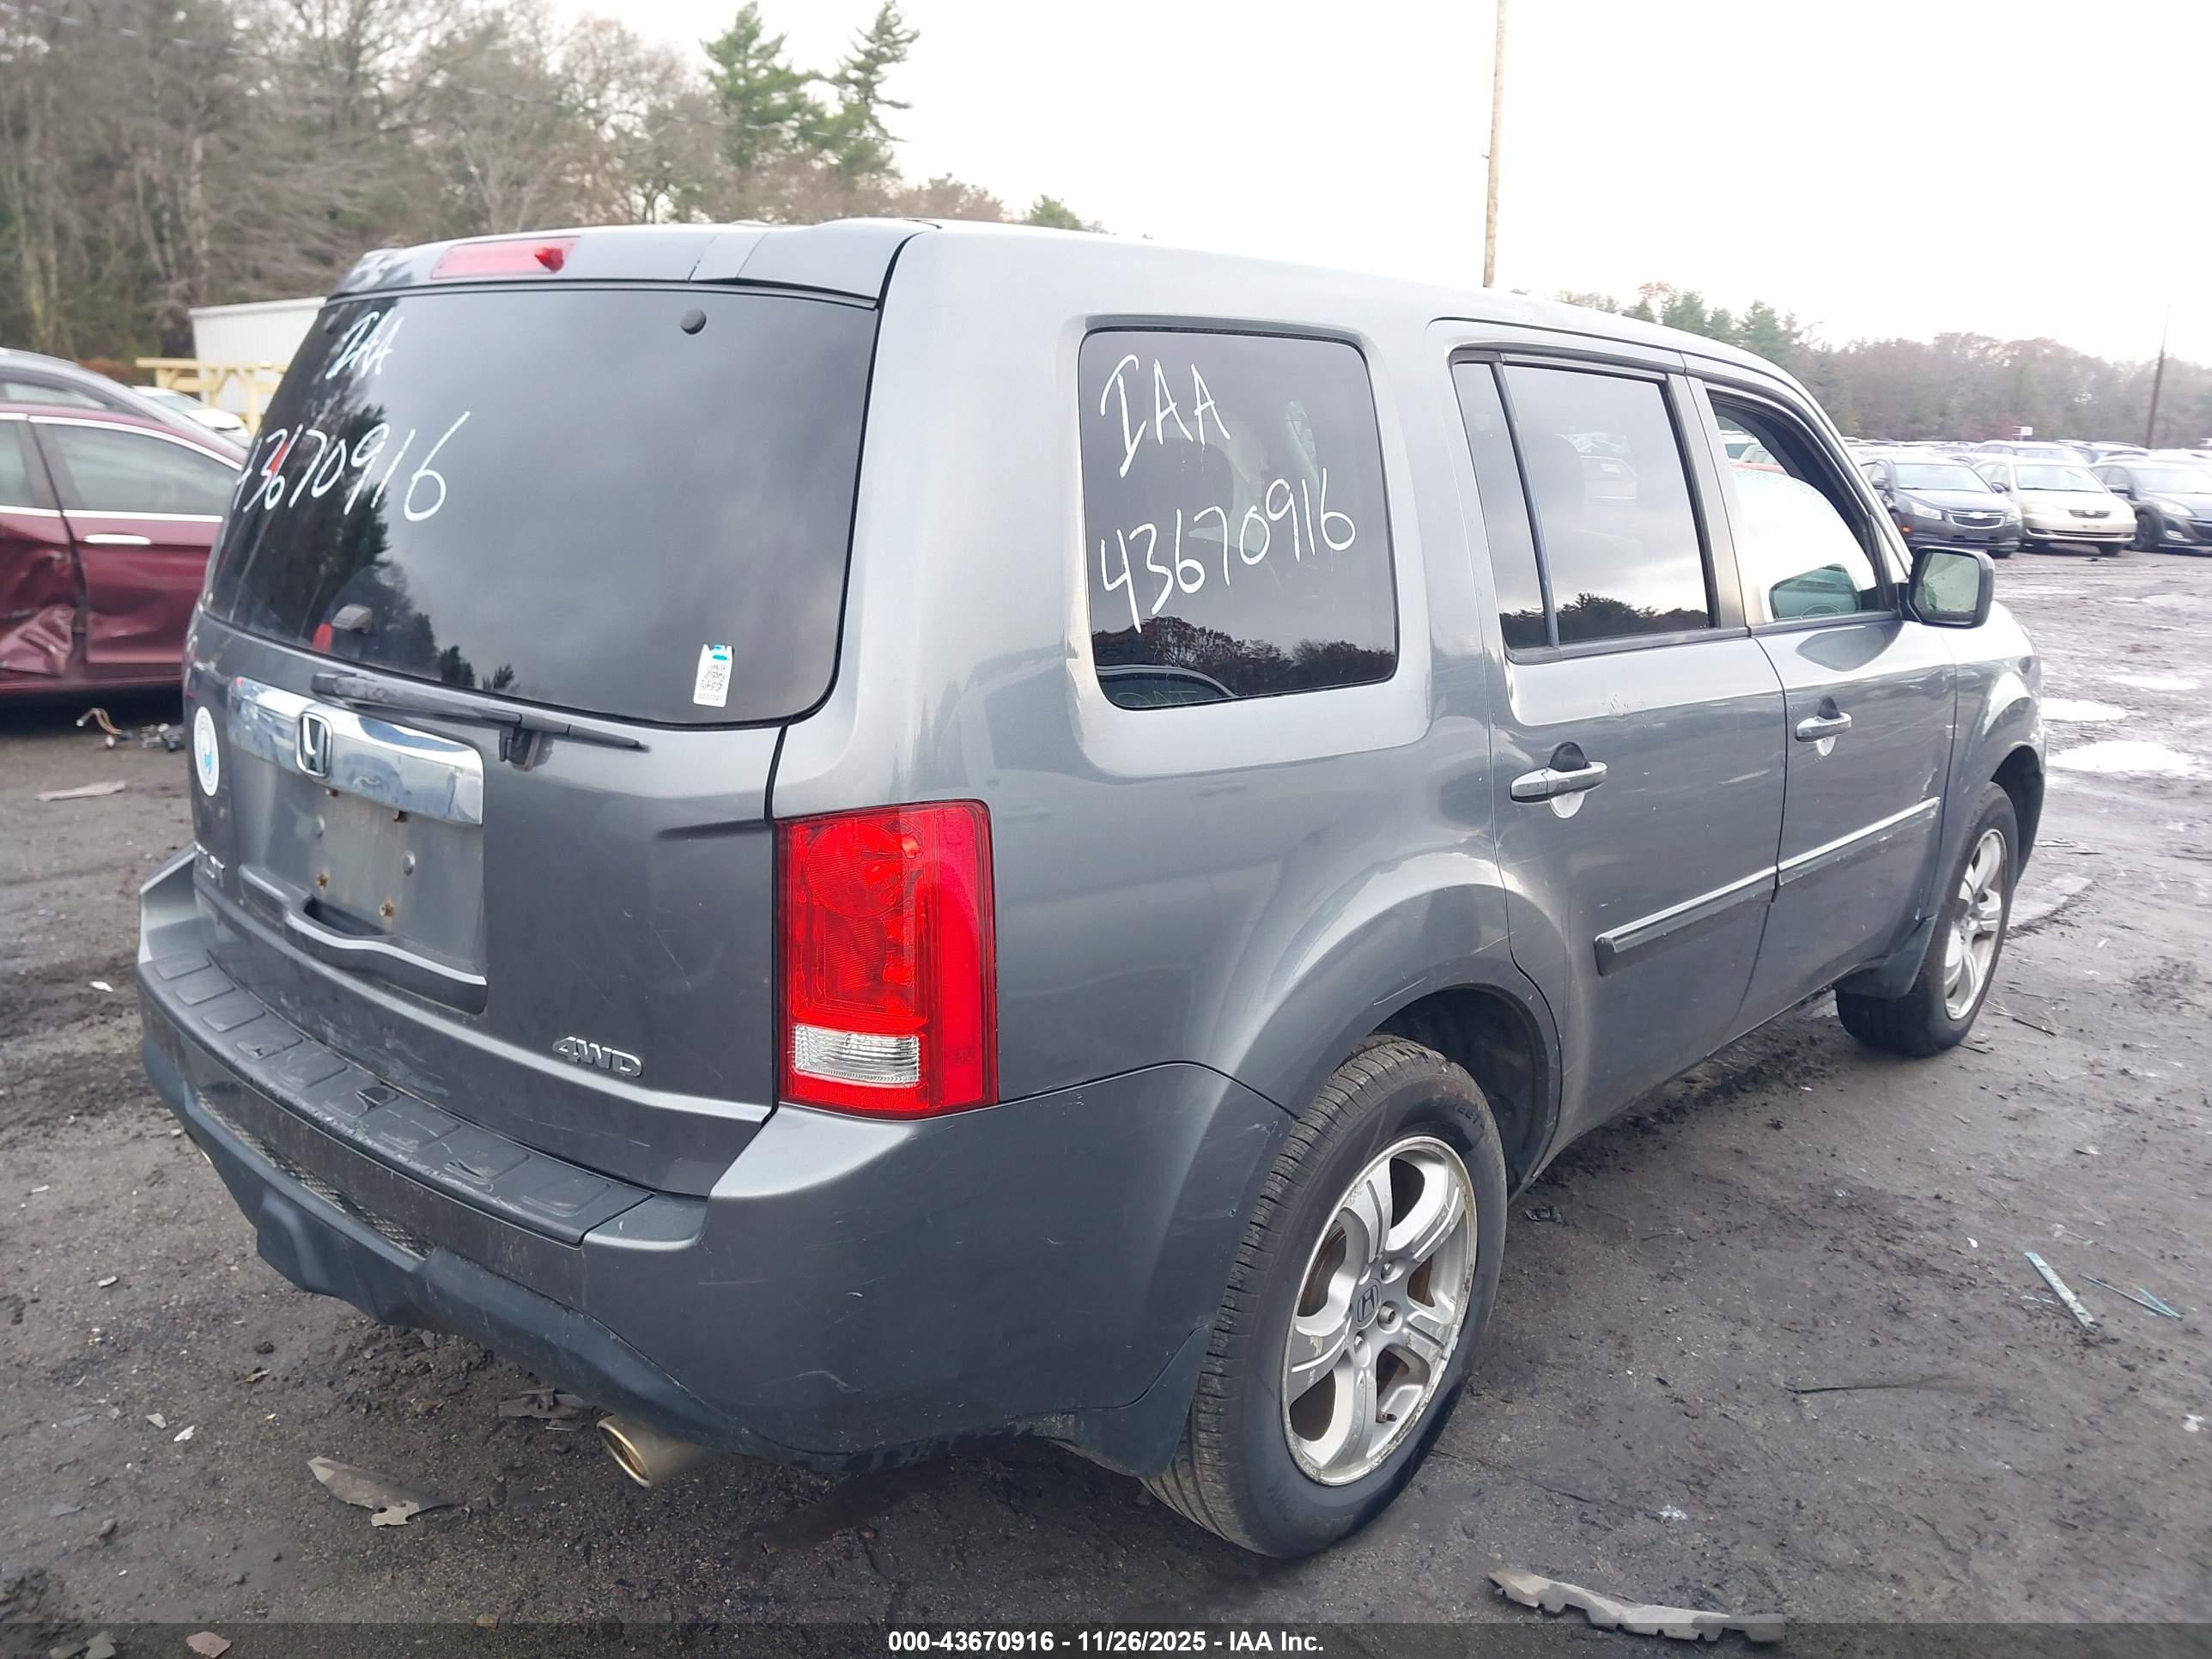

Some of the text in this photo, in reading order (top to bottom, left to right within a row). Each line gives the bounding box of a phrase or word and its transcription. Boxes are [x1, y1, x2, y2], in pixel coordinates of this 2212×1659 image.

[1100, 354, 1231, 477] IAA
[1100, 467, 1356, 634] 43670916
[552, 1036, 643, 1077] 4WD
